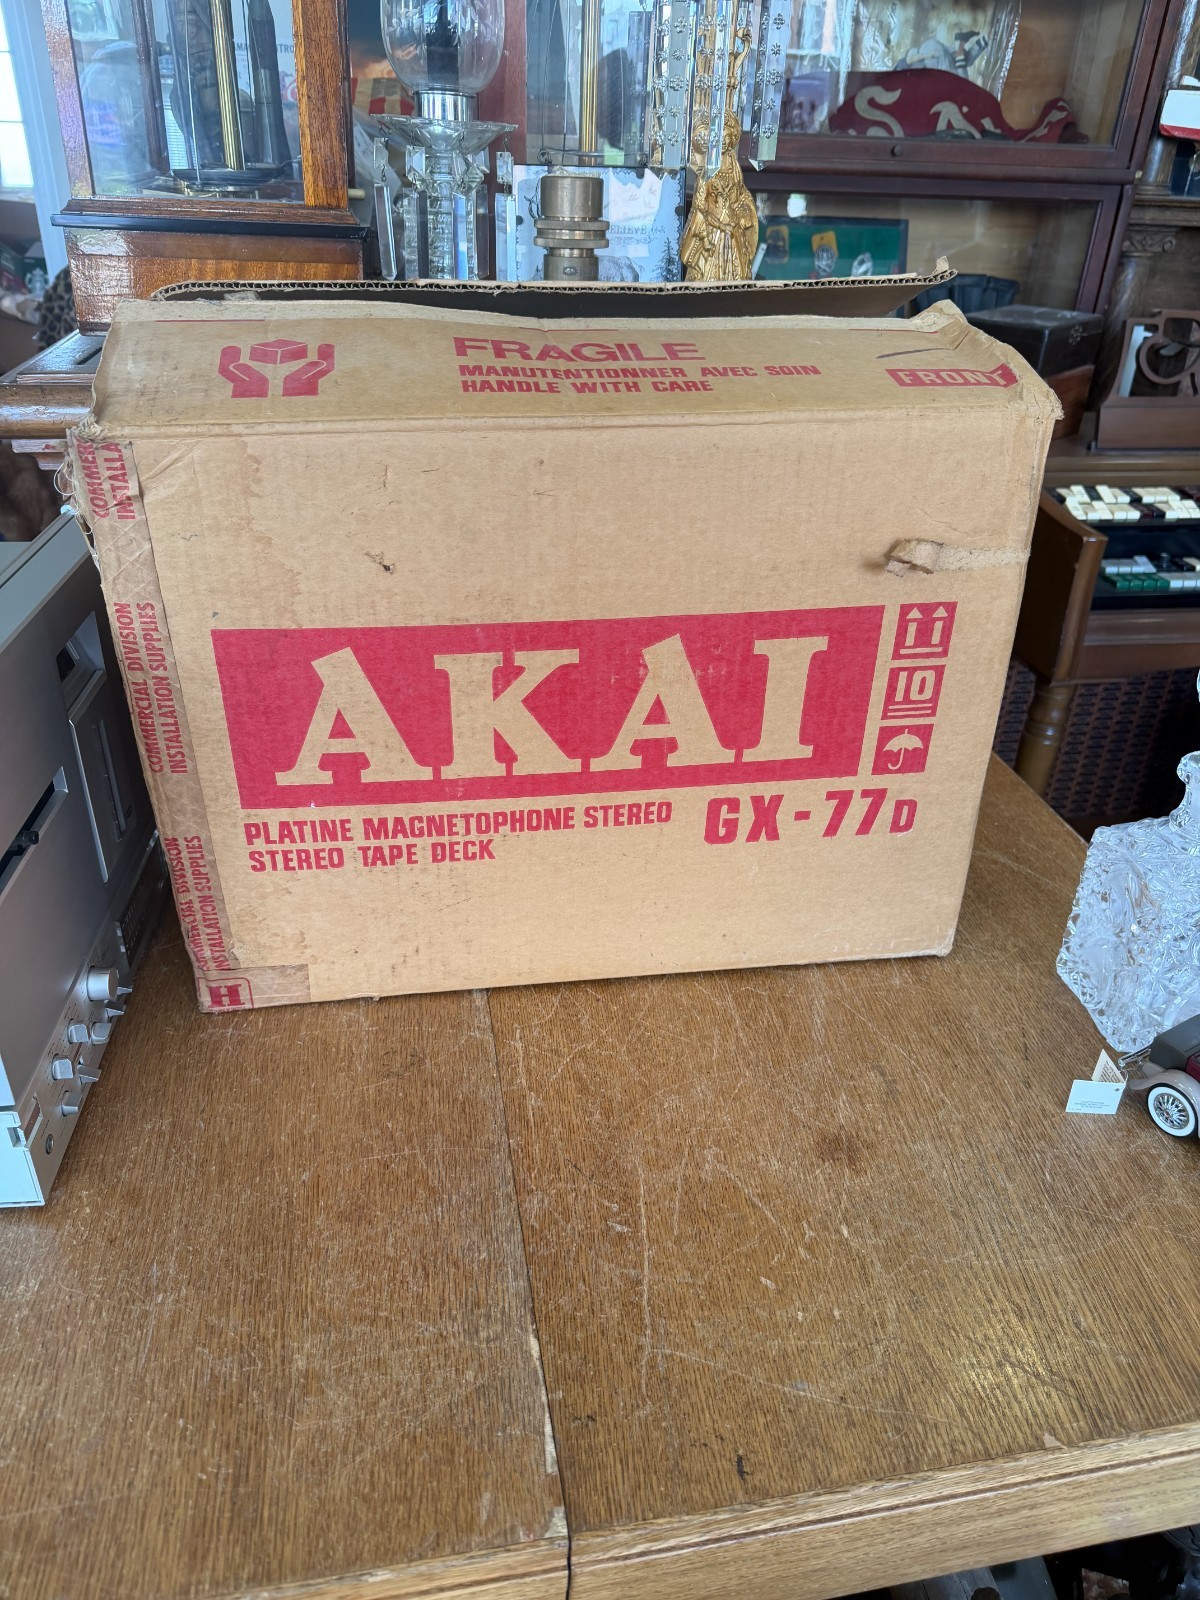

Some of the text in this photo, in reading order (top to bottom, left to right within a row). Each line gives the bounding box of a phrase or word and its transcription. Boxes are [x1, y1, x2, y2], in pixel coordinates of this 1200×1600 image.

[608, 224, 647, 235] ELIEVE
[453, 337, 706, 362] FRAGILE
[459, 364, 821, 380] MANUTENTIONNER AVEC SOIN
[462, 380, 714, 394] HANDLE WITH CARE
[901, 369, 1006, 386] FRONT
[113, 602, 165, 774] COMMERCIAL DIVISION
[136, 602, 188, 774] INSTALLATION SUPPLIES
[895, 669, 936, 702] 10
[275, 633, 829, 786] AKAI
[244, 801, 673, 846] PLATINE MAGNETOPHONE STEREO
[704, 788, 918, 845] GX-77D
[164, 837, 190, 893] DIVISION
[184, 835, 212, 892] SUPPLIES
[248, 838, 496, 873] STEREO TAPE DECK
